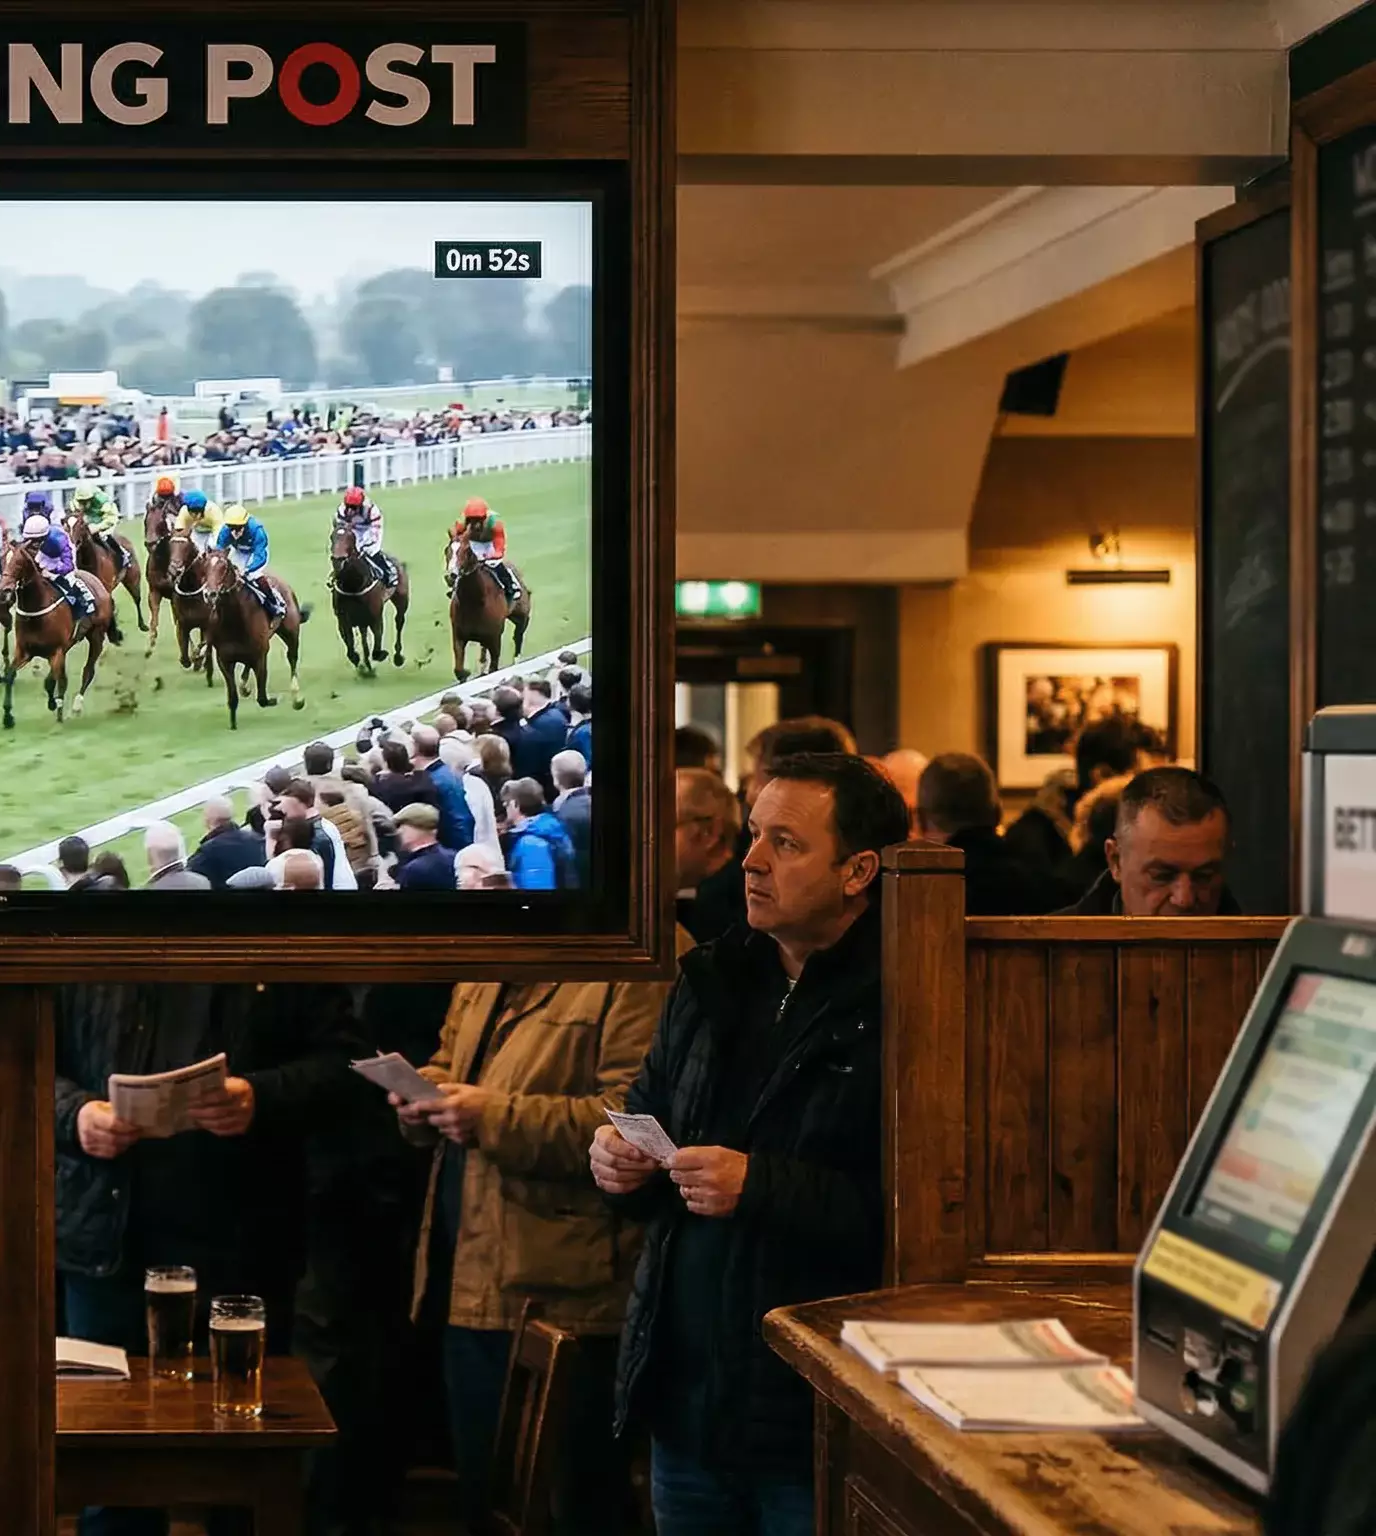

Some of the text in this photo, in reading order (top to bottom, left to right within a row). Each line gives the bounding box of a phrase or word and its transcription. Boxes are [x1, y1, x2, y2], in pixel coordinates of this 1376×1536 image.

[205, 42, 496, 127] POST
[446, 248, 530, 271] 0m 52s
